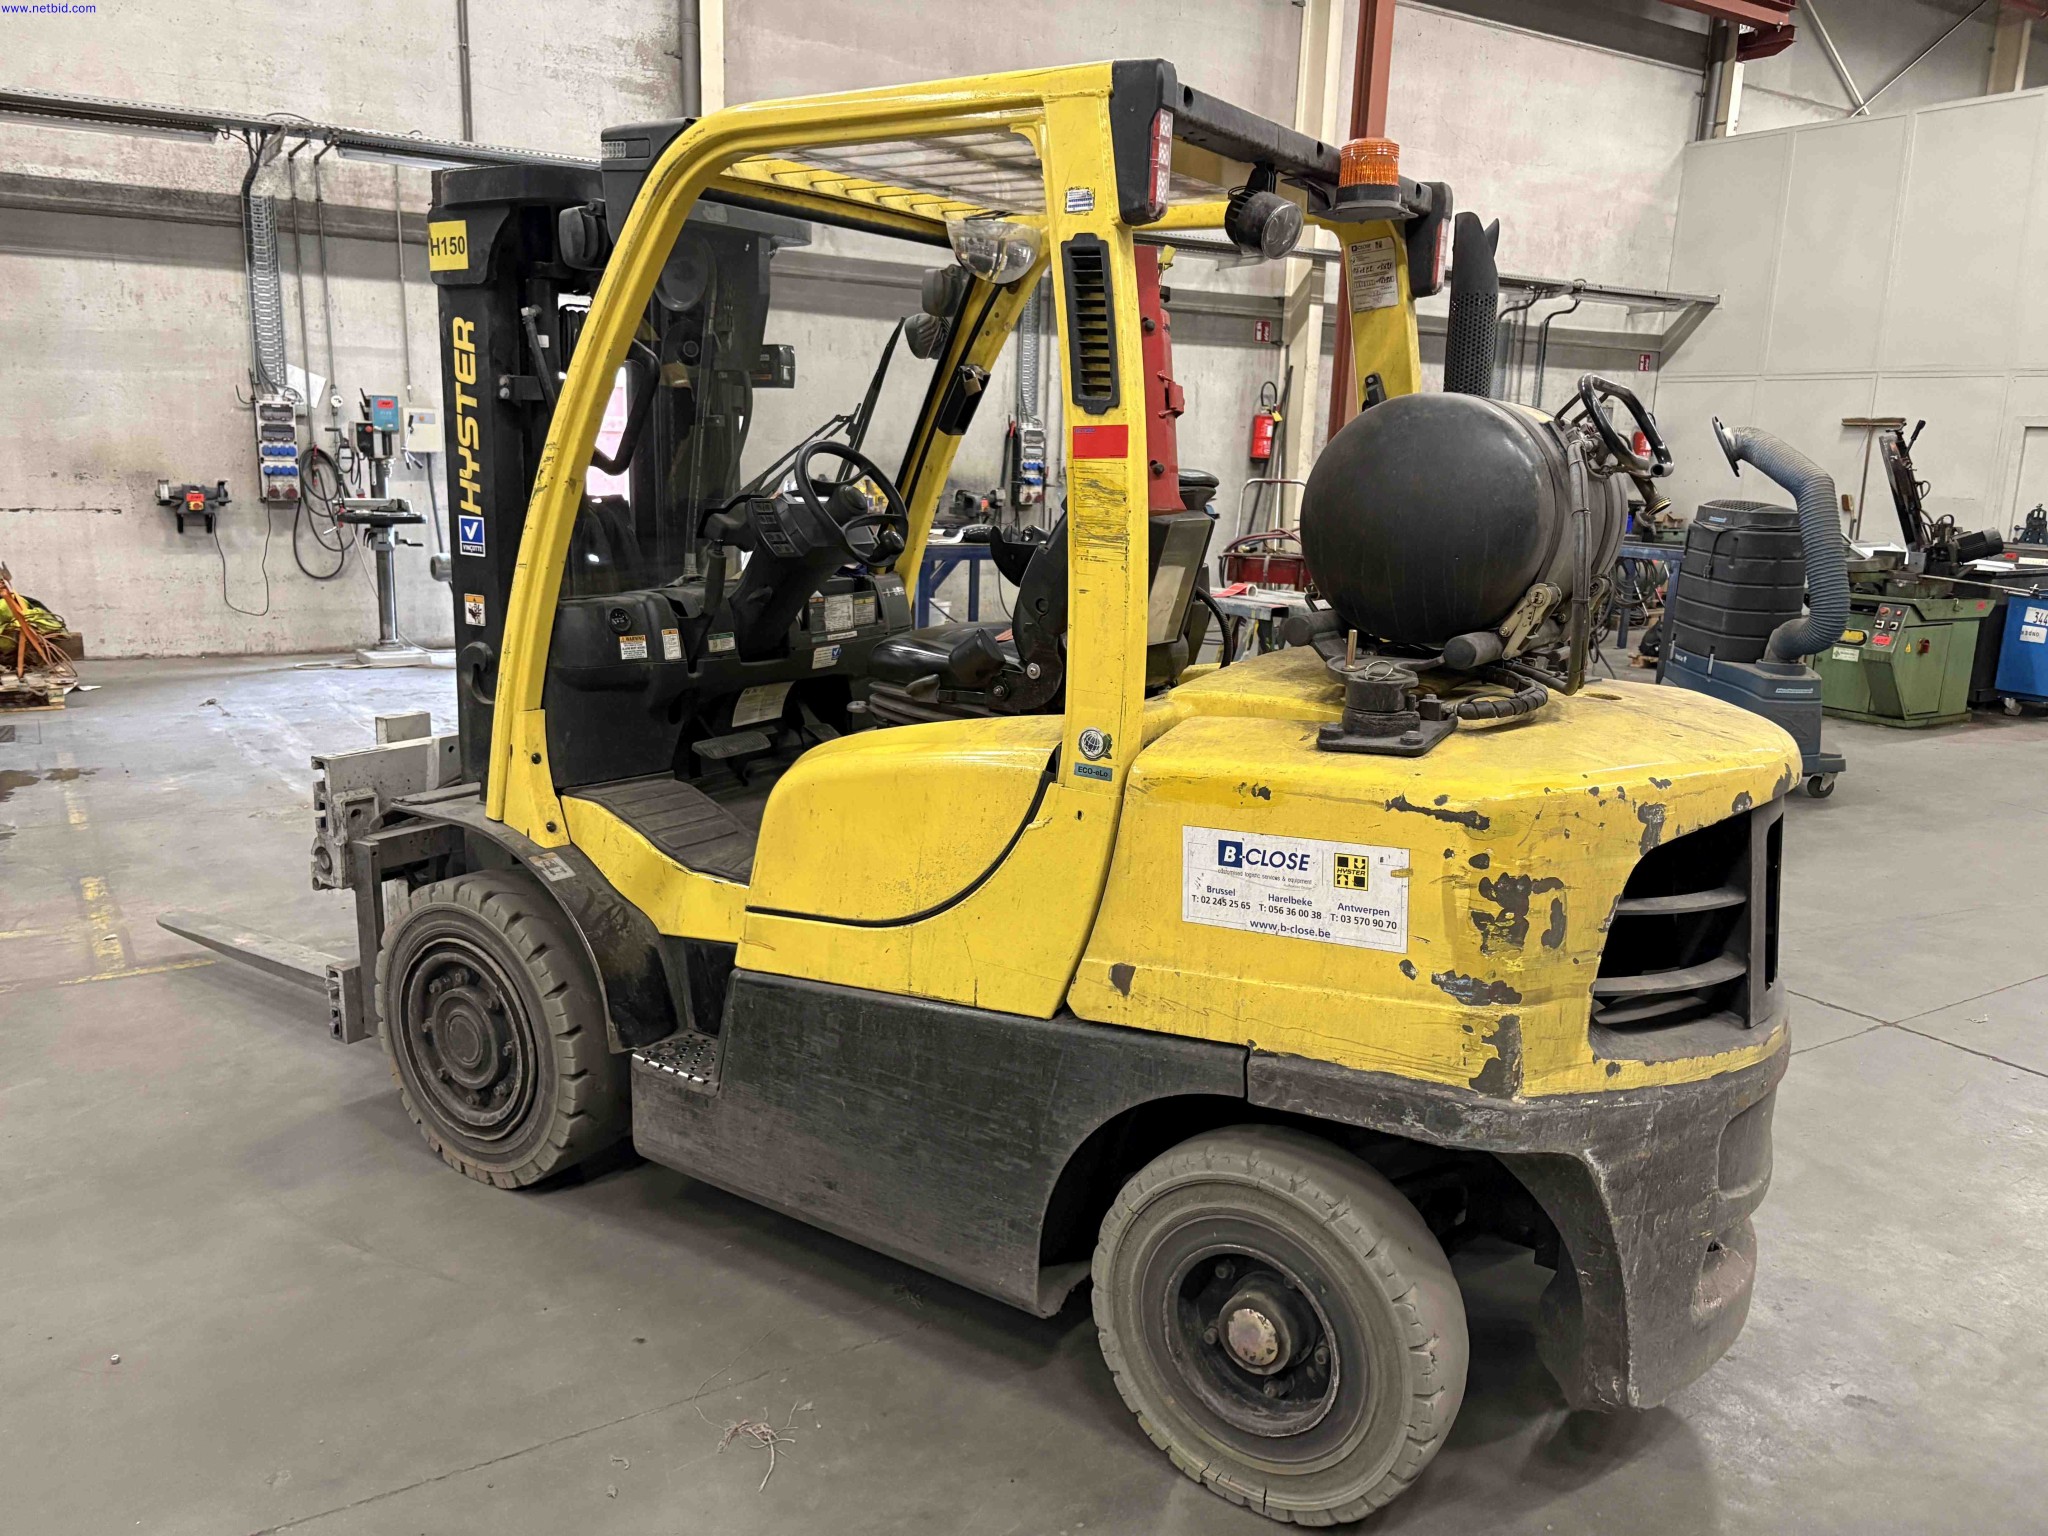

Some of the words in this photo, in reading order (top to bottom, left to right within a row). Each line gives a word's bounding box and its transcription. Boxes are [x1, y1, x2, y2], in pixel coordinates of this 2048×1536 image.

[430, 235, 466, 256] H150
[453, 316, 482, 515] HYSTER
[1223, 845, 1311, 872] B-CLOSE
[1336, 867, 1366, 876] HYSTER
[1287, 878, 1312, 886] equipment
[1206, 885, 1236, 896] Brussel
[1191, 894, 1200, 903] T:
[1200, 895, 1211, 905] 02
[1212, 897, 1227, 907] 245
[1228, 899, 1239, 909] 25
[1240, 901, 1251, 910] 65
[1267, 893, 1313, 907] Harelbeke
[1258, 903, 1267, 912] T:
[1268, 905, 1284, 914] 056
[1285, 907, 1297, 916] 36
[1298, 909, 1309, 918] 00
[1310, 910, 1322, 919] 38
[1337, 902, 1390, 917] Antwerpen
[1249, 920, 1331, 938] www.b-close.be
[1330, 913, 1339, 922] T:
[1340, 914, 1352, 924] 03
[1353, 916, 1370, 926] 570
[1372, 919, 1384, 928] 90
[1385, 920, 1397, 930] 70
